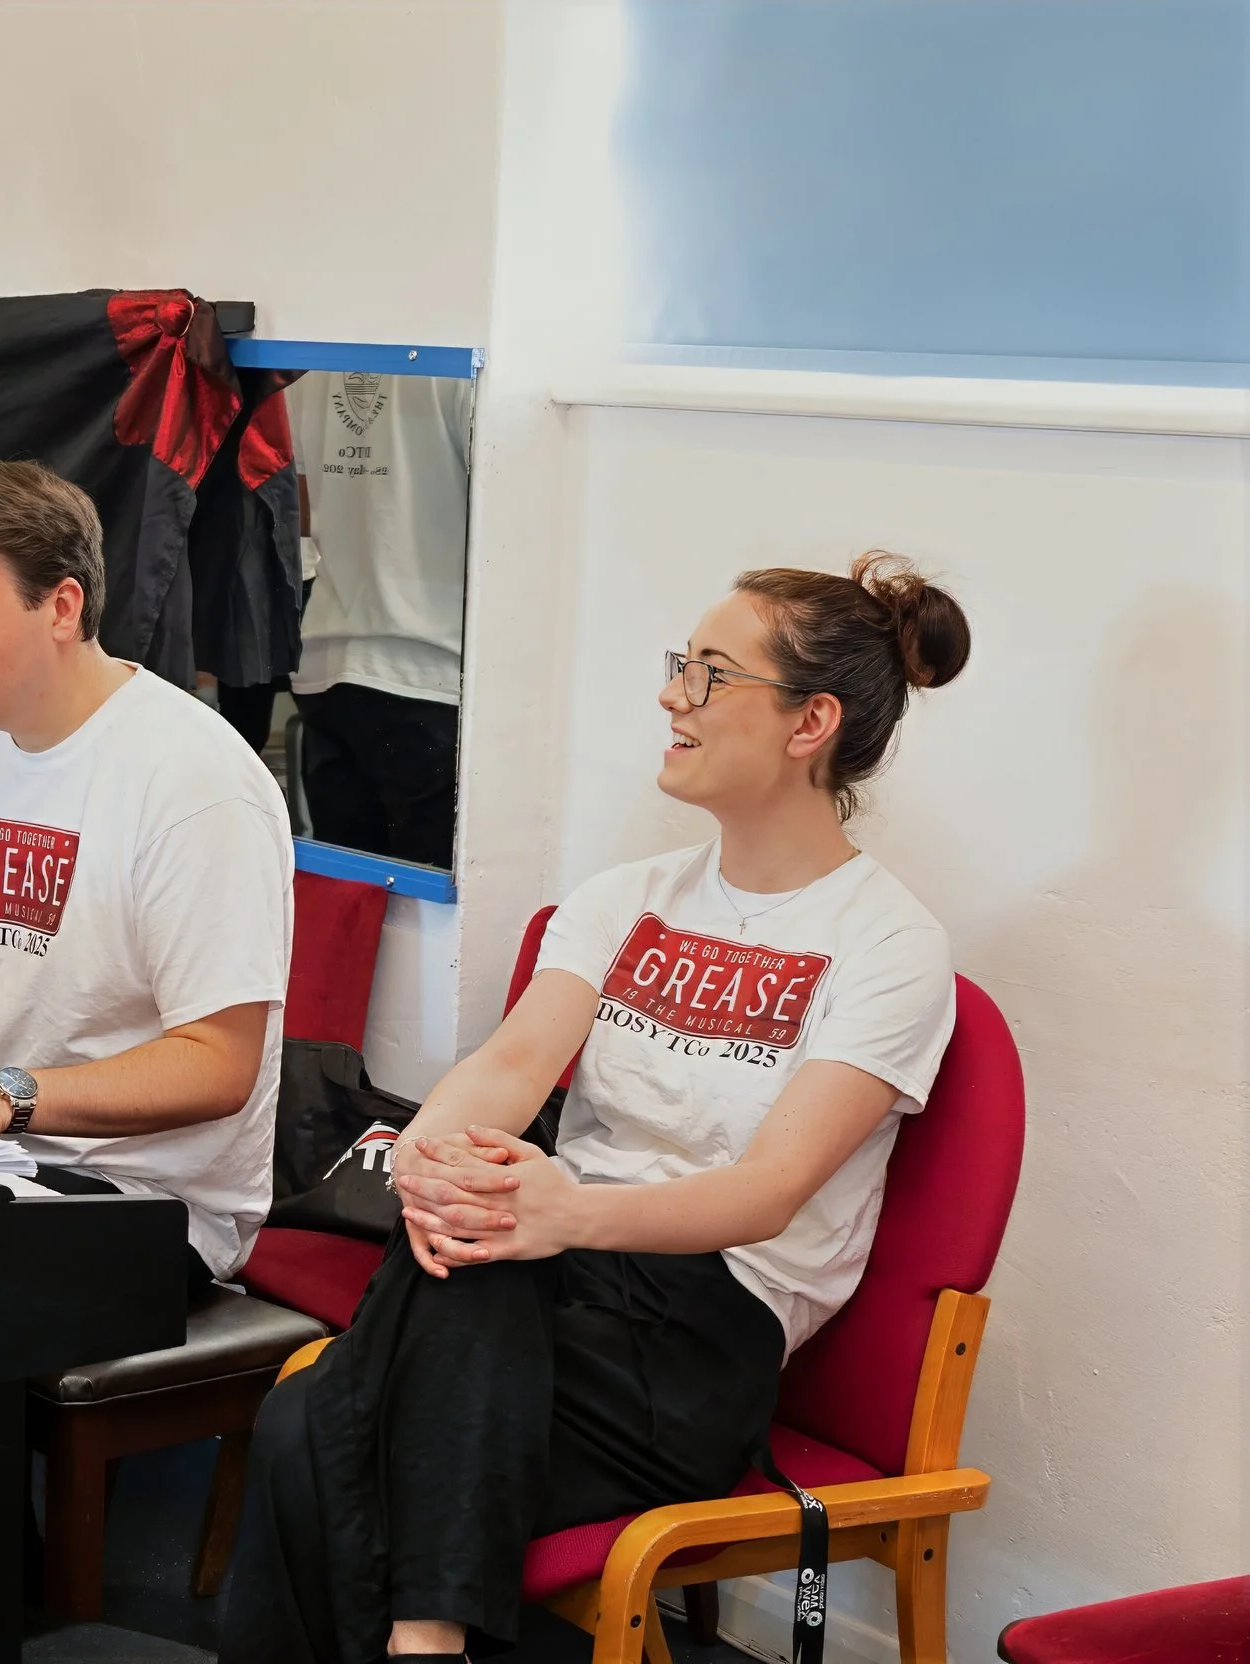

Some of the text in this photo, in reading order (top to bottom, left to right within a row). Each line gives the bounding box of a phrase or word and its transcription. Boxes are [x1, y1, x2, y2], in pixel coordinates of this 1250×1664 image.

[0, 827, 11, 842] GO
[17, 830, 56, 849] TOGETHER
[5, 902, 44, 923] MUSICAL
[24, 932, 51, 957] 2025
[679, 939, 786, 970] WE GO TOGETHER
[632, 947, 806, 1022] GREASE
[621, 987, 787, 1040] 19 THE MUSICAL 59
[719, 1041, 780, 1068] 2025
